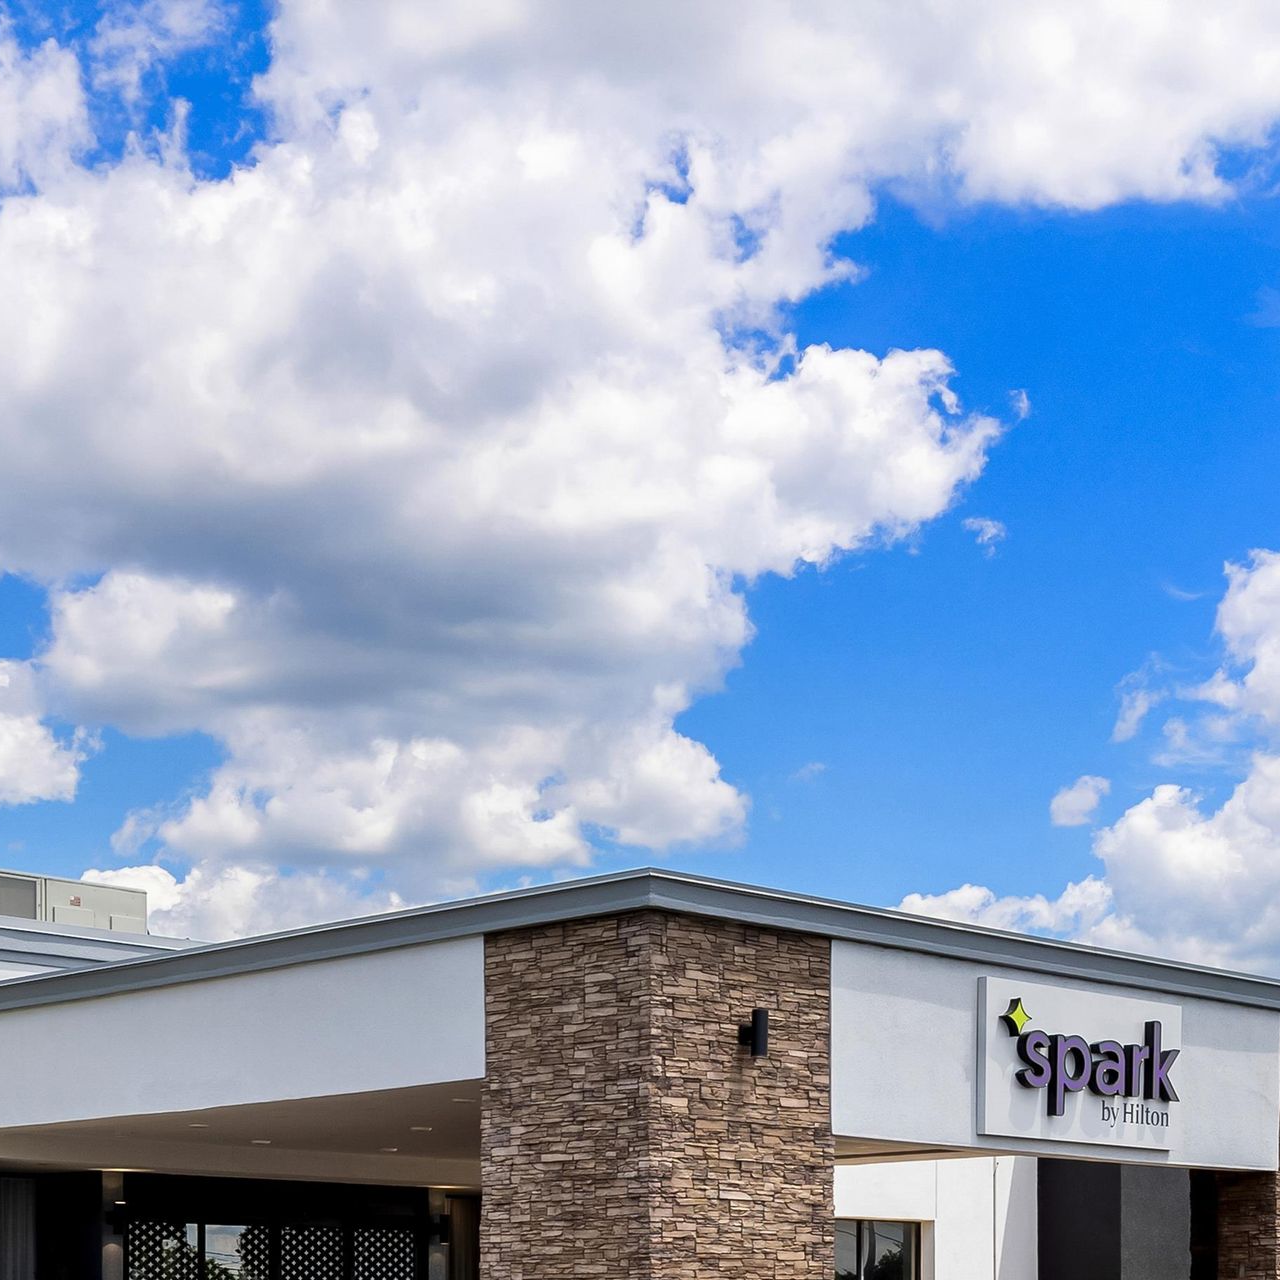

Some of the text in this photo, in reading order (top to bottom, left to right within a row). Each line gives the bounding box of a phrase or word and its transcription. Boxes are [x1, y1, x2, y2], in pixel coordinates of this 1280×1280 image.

[1015, 1020, 1180, 1117] spark
[1101, 1100, 1170, 1128] by Hilton
